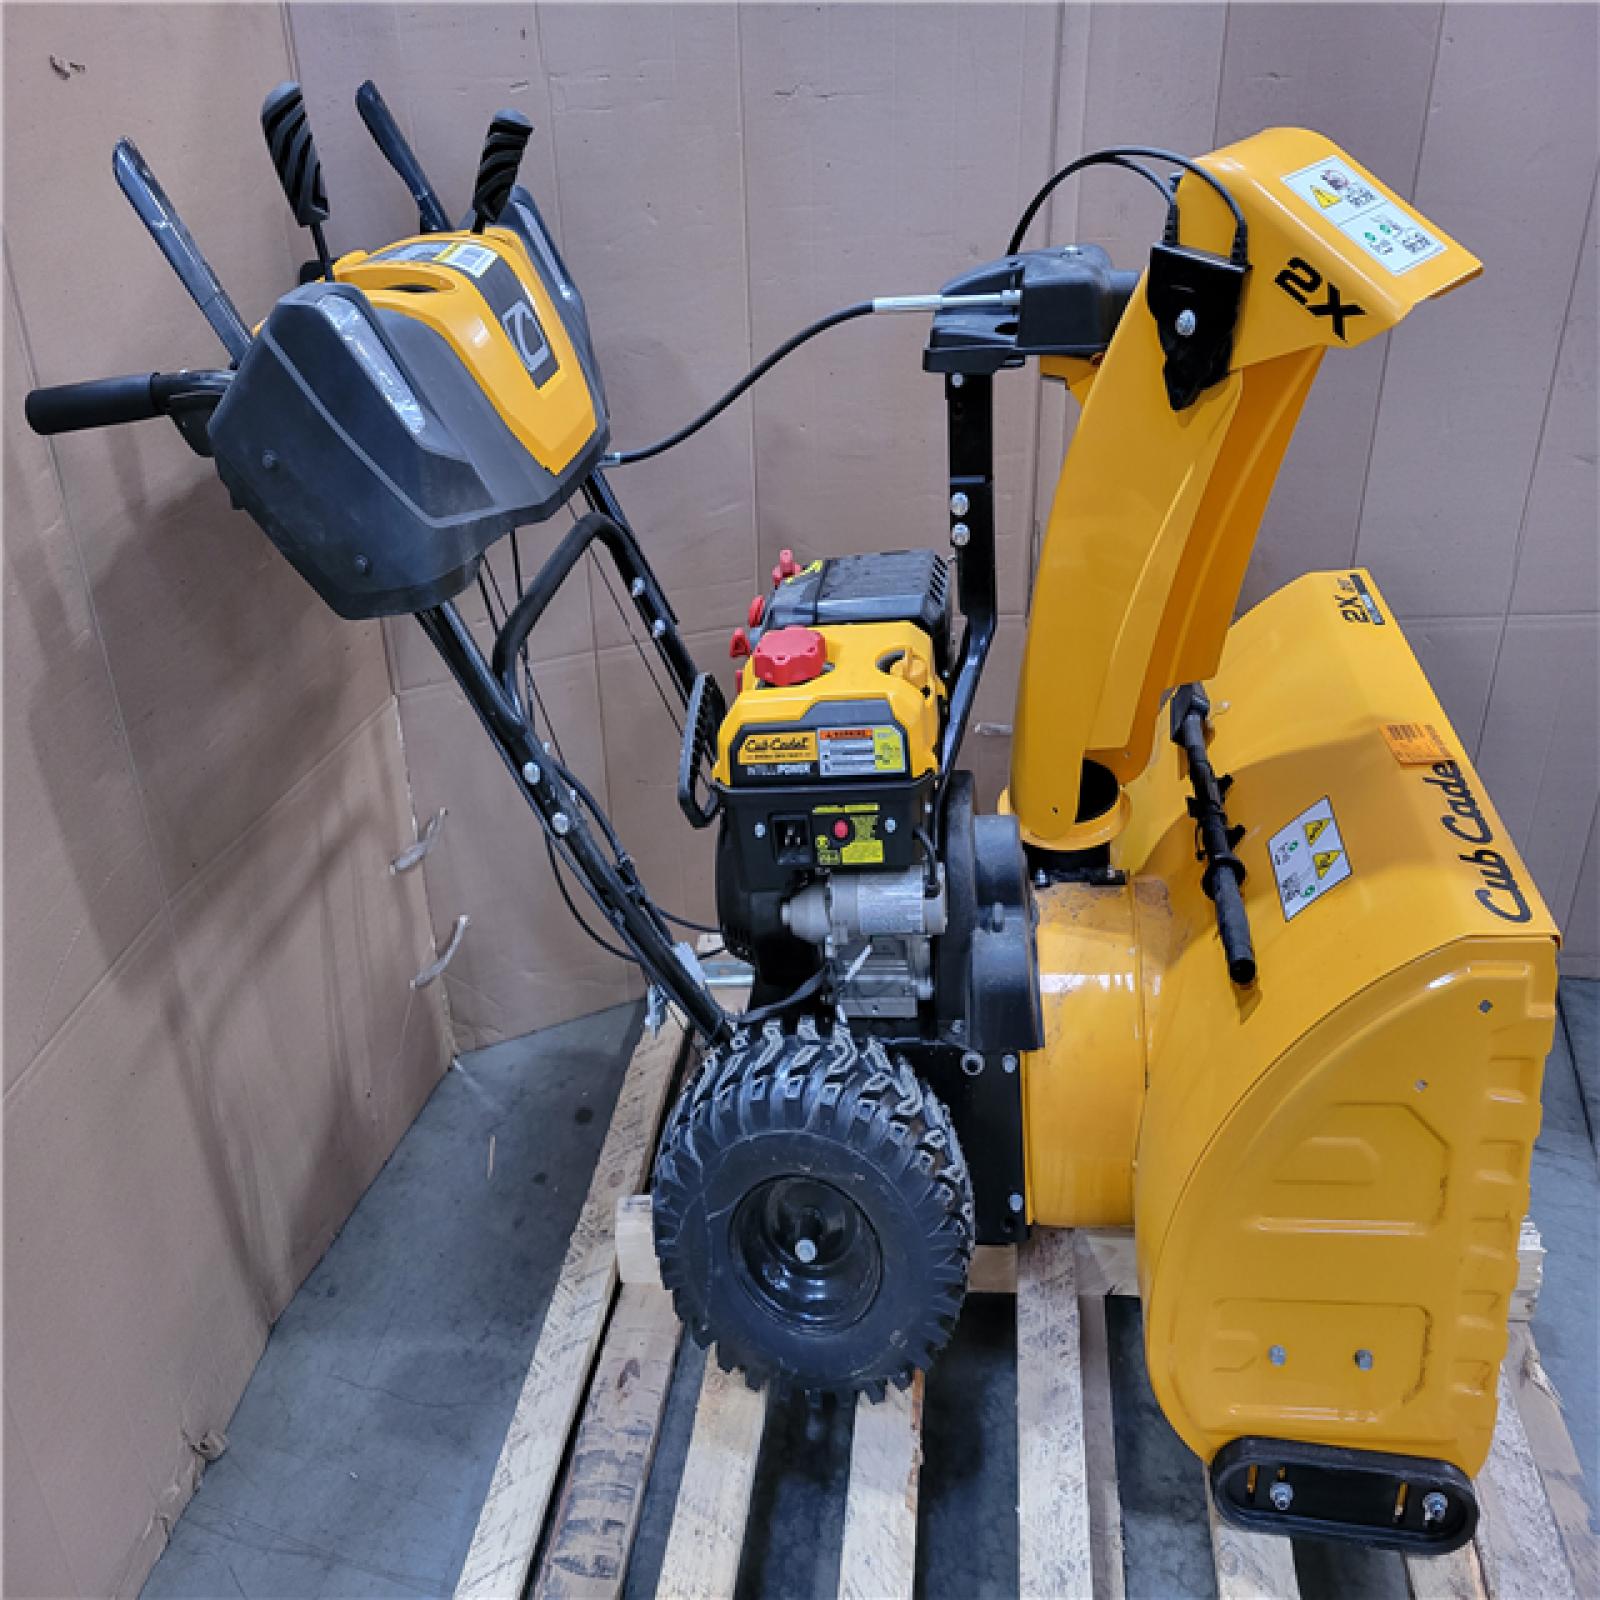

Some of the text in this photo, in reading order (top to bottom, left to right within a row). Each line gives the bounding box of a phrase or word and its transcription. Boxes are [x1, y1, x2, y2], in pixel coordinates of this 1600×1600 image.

[1275, 257, 1366, 342] 2X
[1335, 594, 1369, 623] 2X
[1422, 760, 1532, 923] Cub Cade
